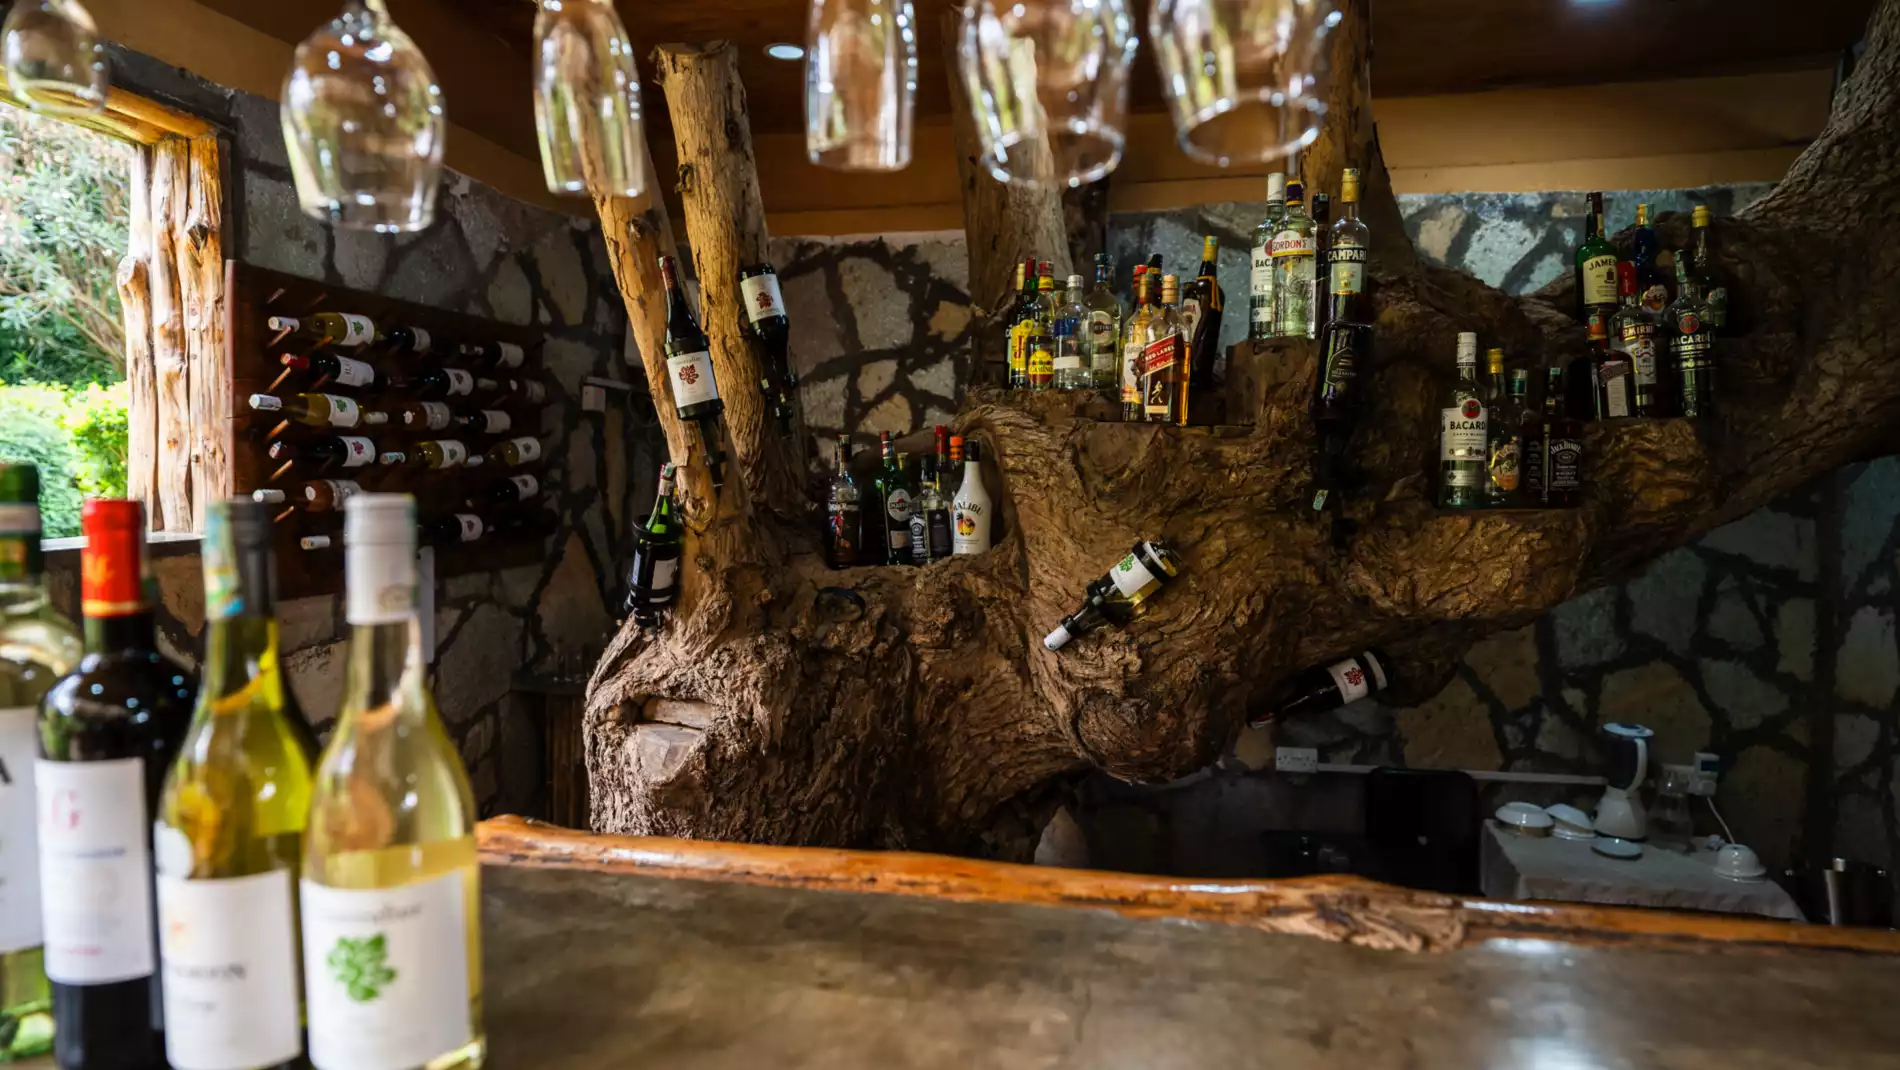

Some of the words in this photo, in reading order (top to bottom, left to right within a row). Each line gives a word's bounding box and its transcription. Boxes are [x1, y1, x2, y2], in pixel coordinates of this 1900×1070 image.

[1328, 249, 1366, 261] CAMPARI
[1145, 353, 1157, 361] RED
[1156, 345, 1175, 356] LABEL
